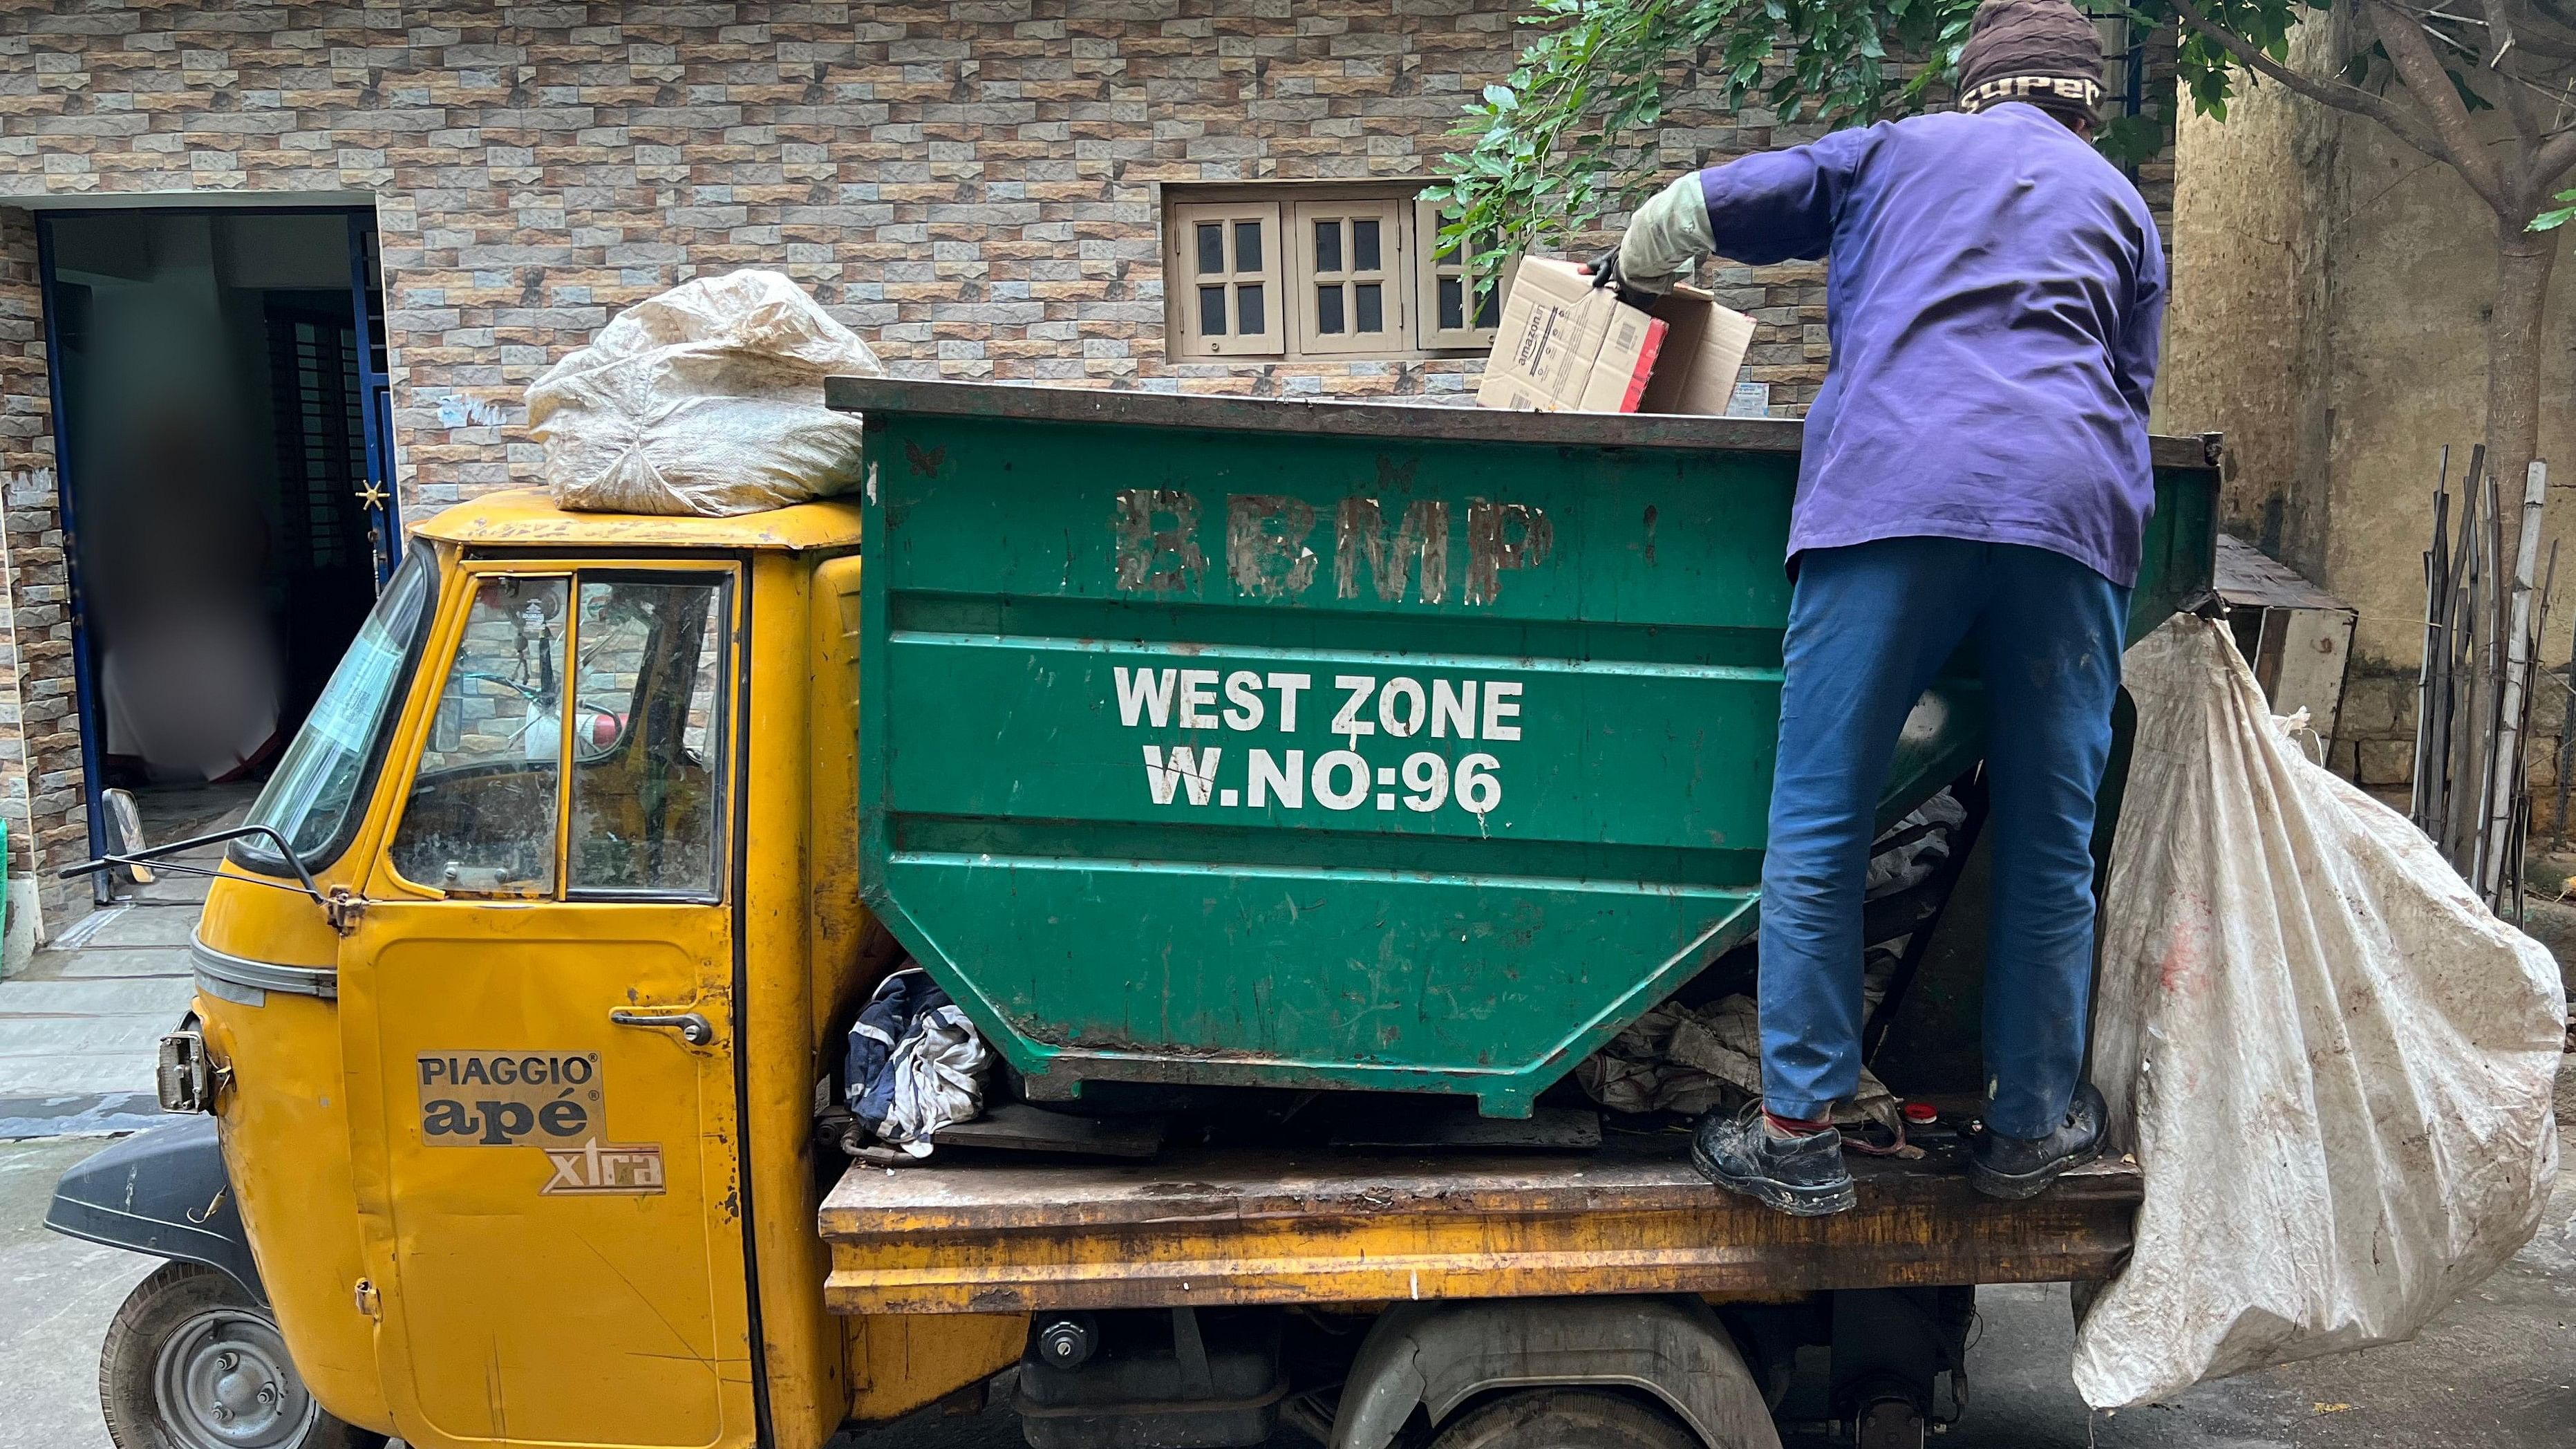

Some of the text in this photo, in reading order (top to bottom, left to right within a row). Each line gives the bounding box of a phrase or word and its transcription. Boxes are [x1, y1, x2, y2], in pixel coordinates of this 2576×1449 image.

[1518, 304, 1545, 366] amazon.in
[1114, 489, 1554, 606] BBMP
[1113, 666, 1523, 741] WEST ZONE
[1142, 745, 1502, 813] W.NO:96
[417, 1057, 592, 1085] PIAGGIO
[423, 1087, 587, 1145] apé
